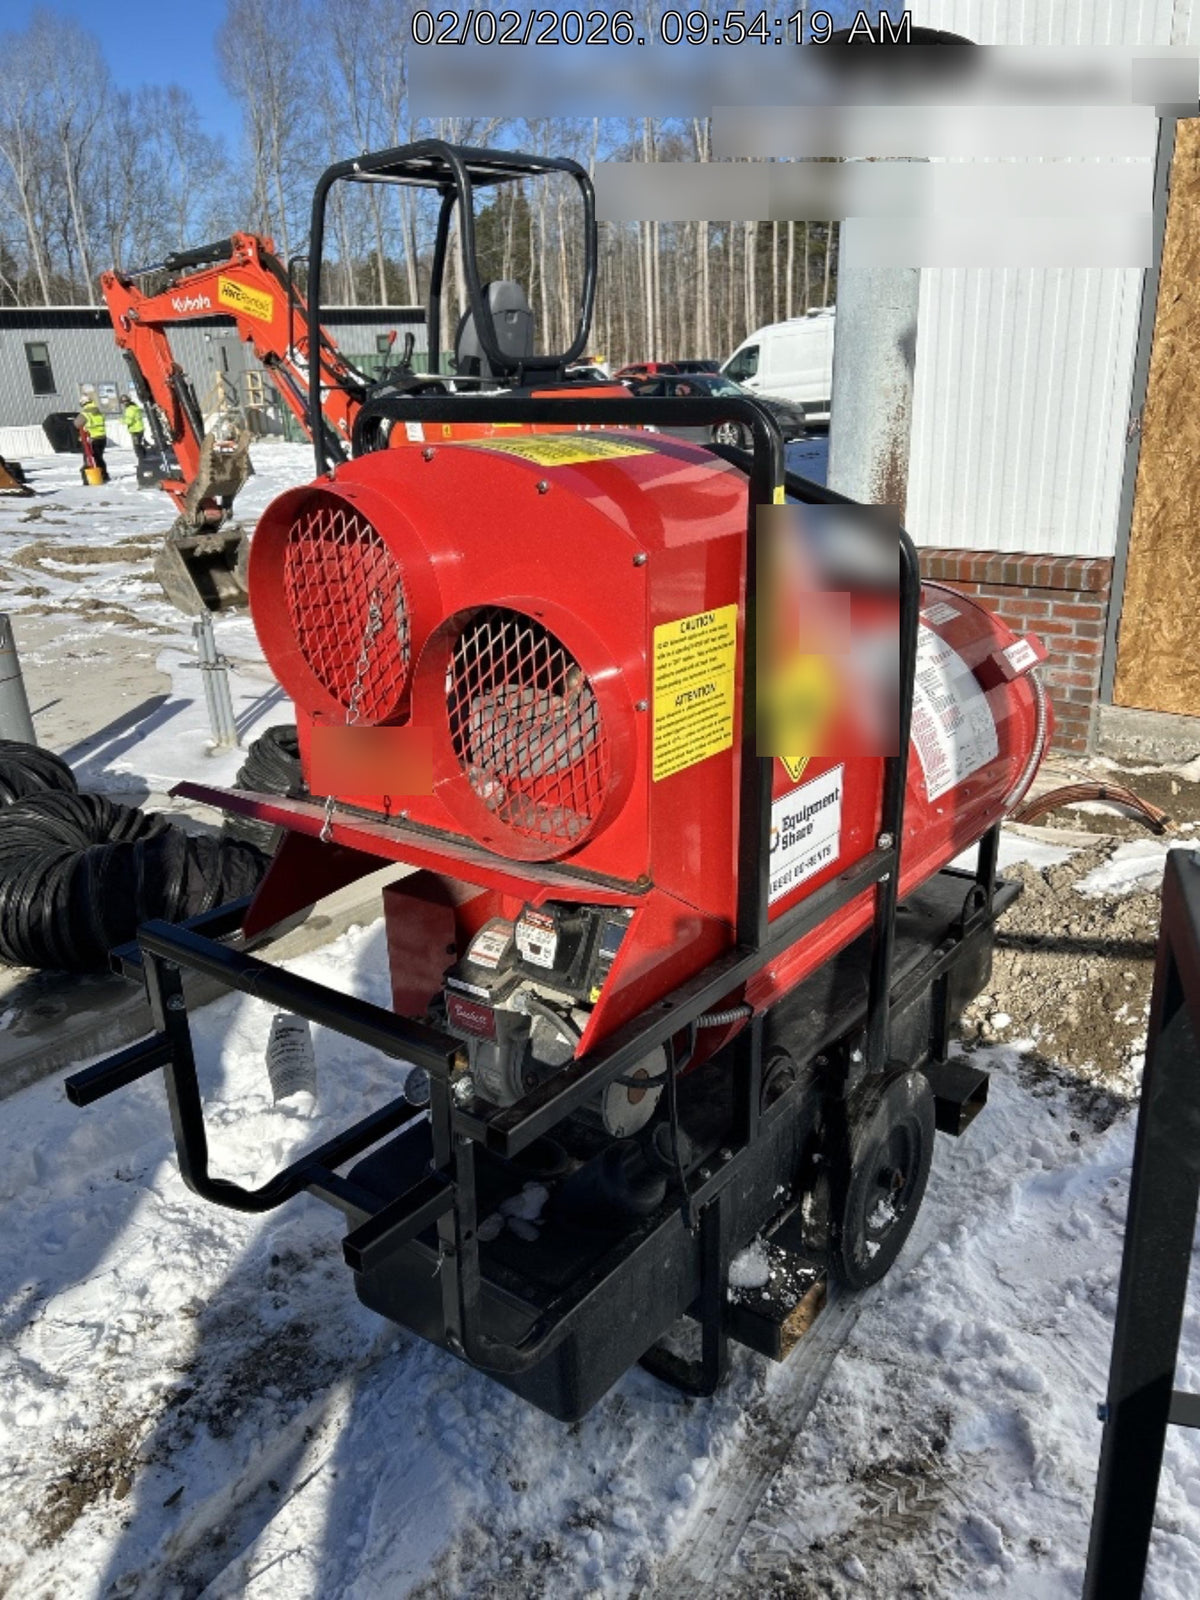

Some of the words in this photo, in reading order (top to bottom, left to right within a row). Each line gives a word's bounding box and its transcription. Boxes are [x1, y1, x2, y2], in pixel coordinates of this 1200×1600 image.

[171, 293, 212, 313] Kubota
[680, 613, 716, 634] CAUTION
[675, 683, 716, 706] ATTENTION
[781, 787, 840, 832] Equipment
[781, 822, 814, 851] Share
